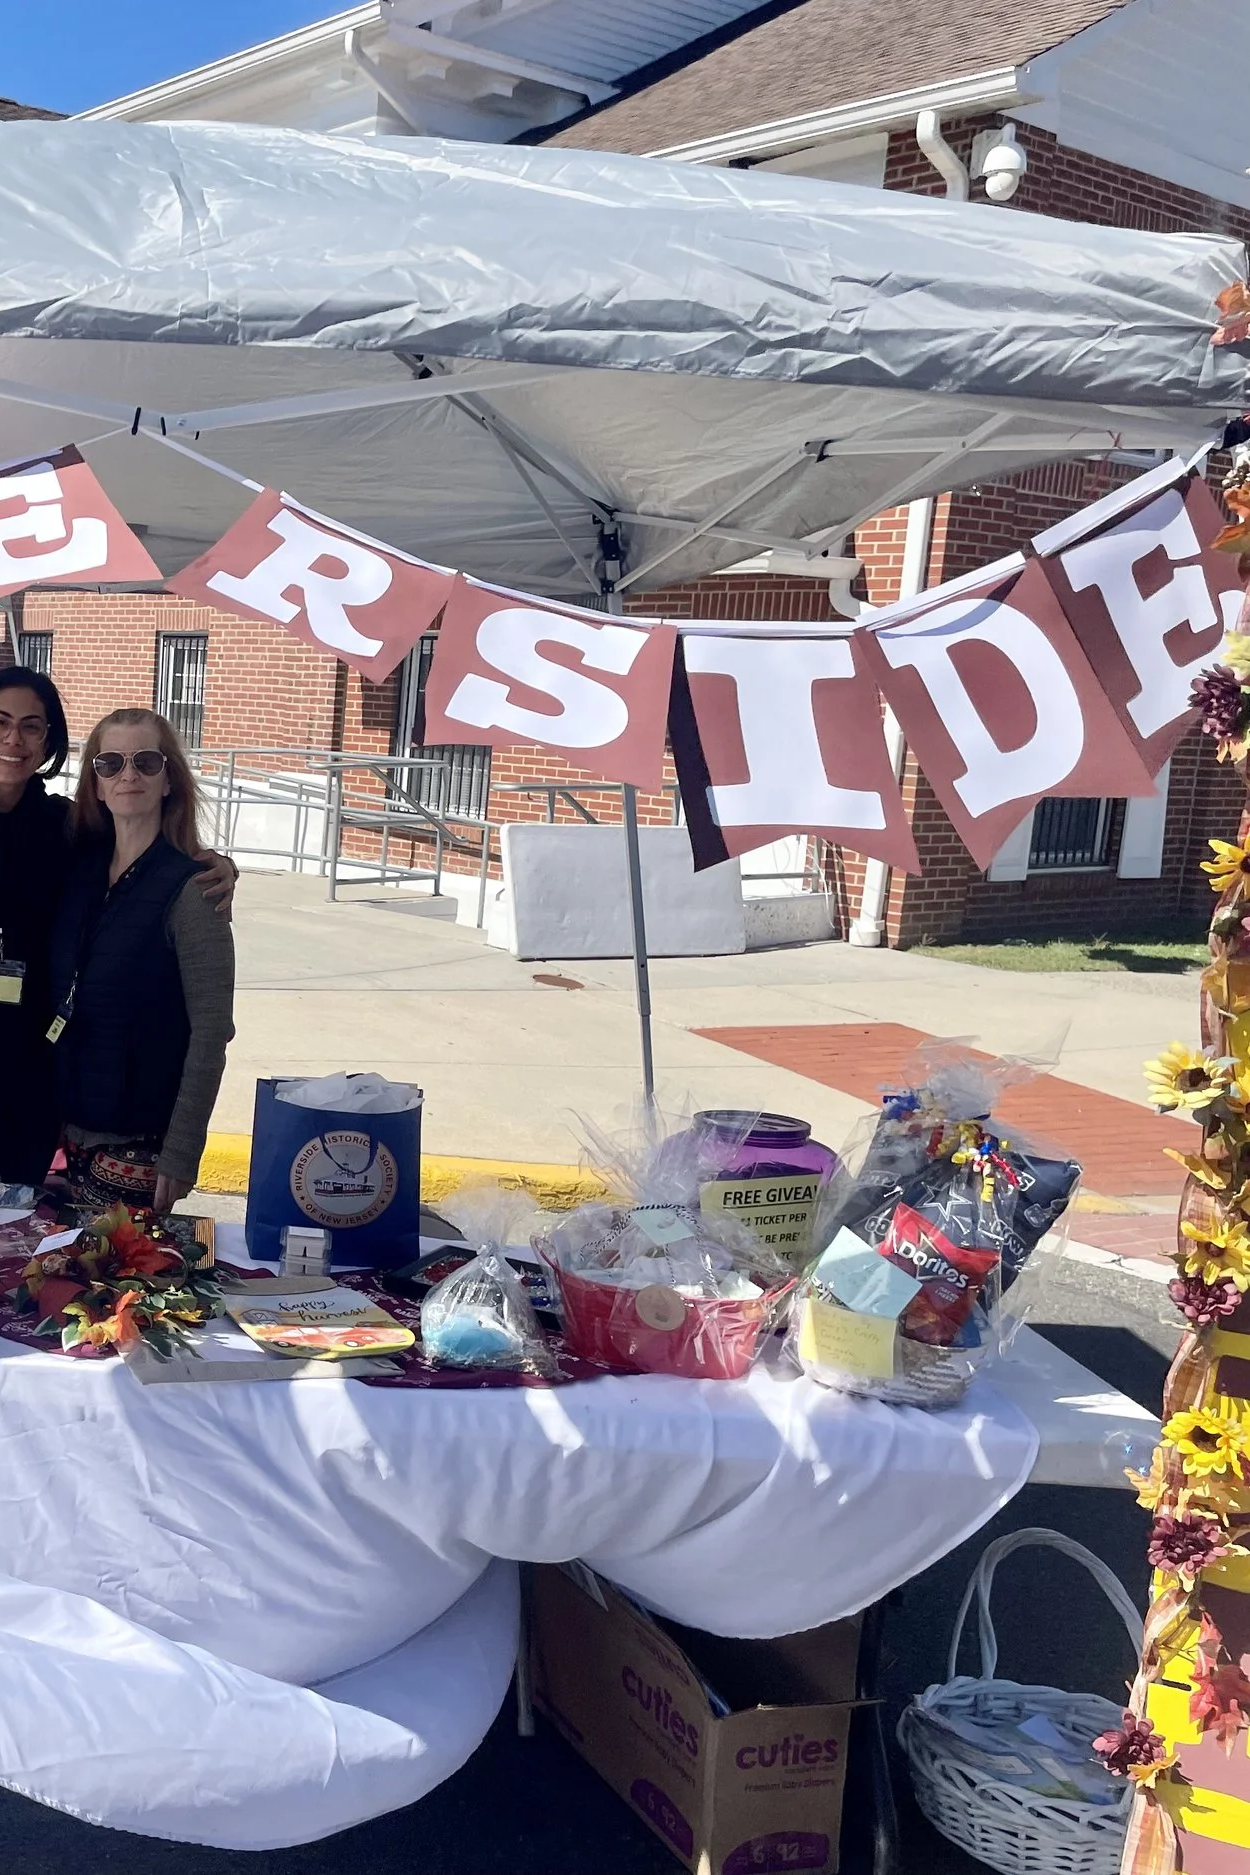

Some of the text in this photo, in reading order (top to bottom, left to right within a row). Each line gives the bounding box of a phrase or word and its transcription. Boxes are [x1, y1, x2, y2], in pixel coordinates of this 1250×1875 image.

[294, 1143, 320, 1192] RIVERSIDE
[379, 1153, 395, 1196] SOCIETY
[722, 1189, 762, 1206] FREE
[305, 1203, 379, 1225] OF NEW JERSEY
[754, 1214, 787, 1226] TICKET
[788, 1212, 807, 1223] PER
[765, 1234, 777, 1244] BE
[898, 1239, 970, 1290] Doritos
[279, 1300, 335, 1312] happy
[297, 1305, 370, 1322] harvest
[621, 1664, 700, 1760] cuties
[735, 1733, 839, 1770] cuties
[752, 1841, 800, 1864] 6 92
